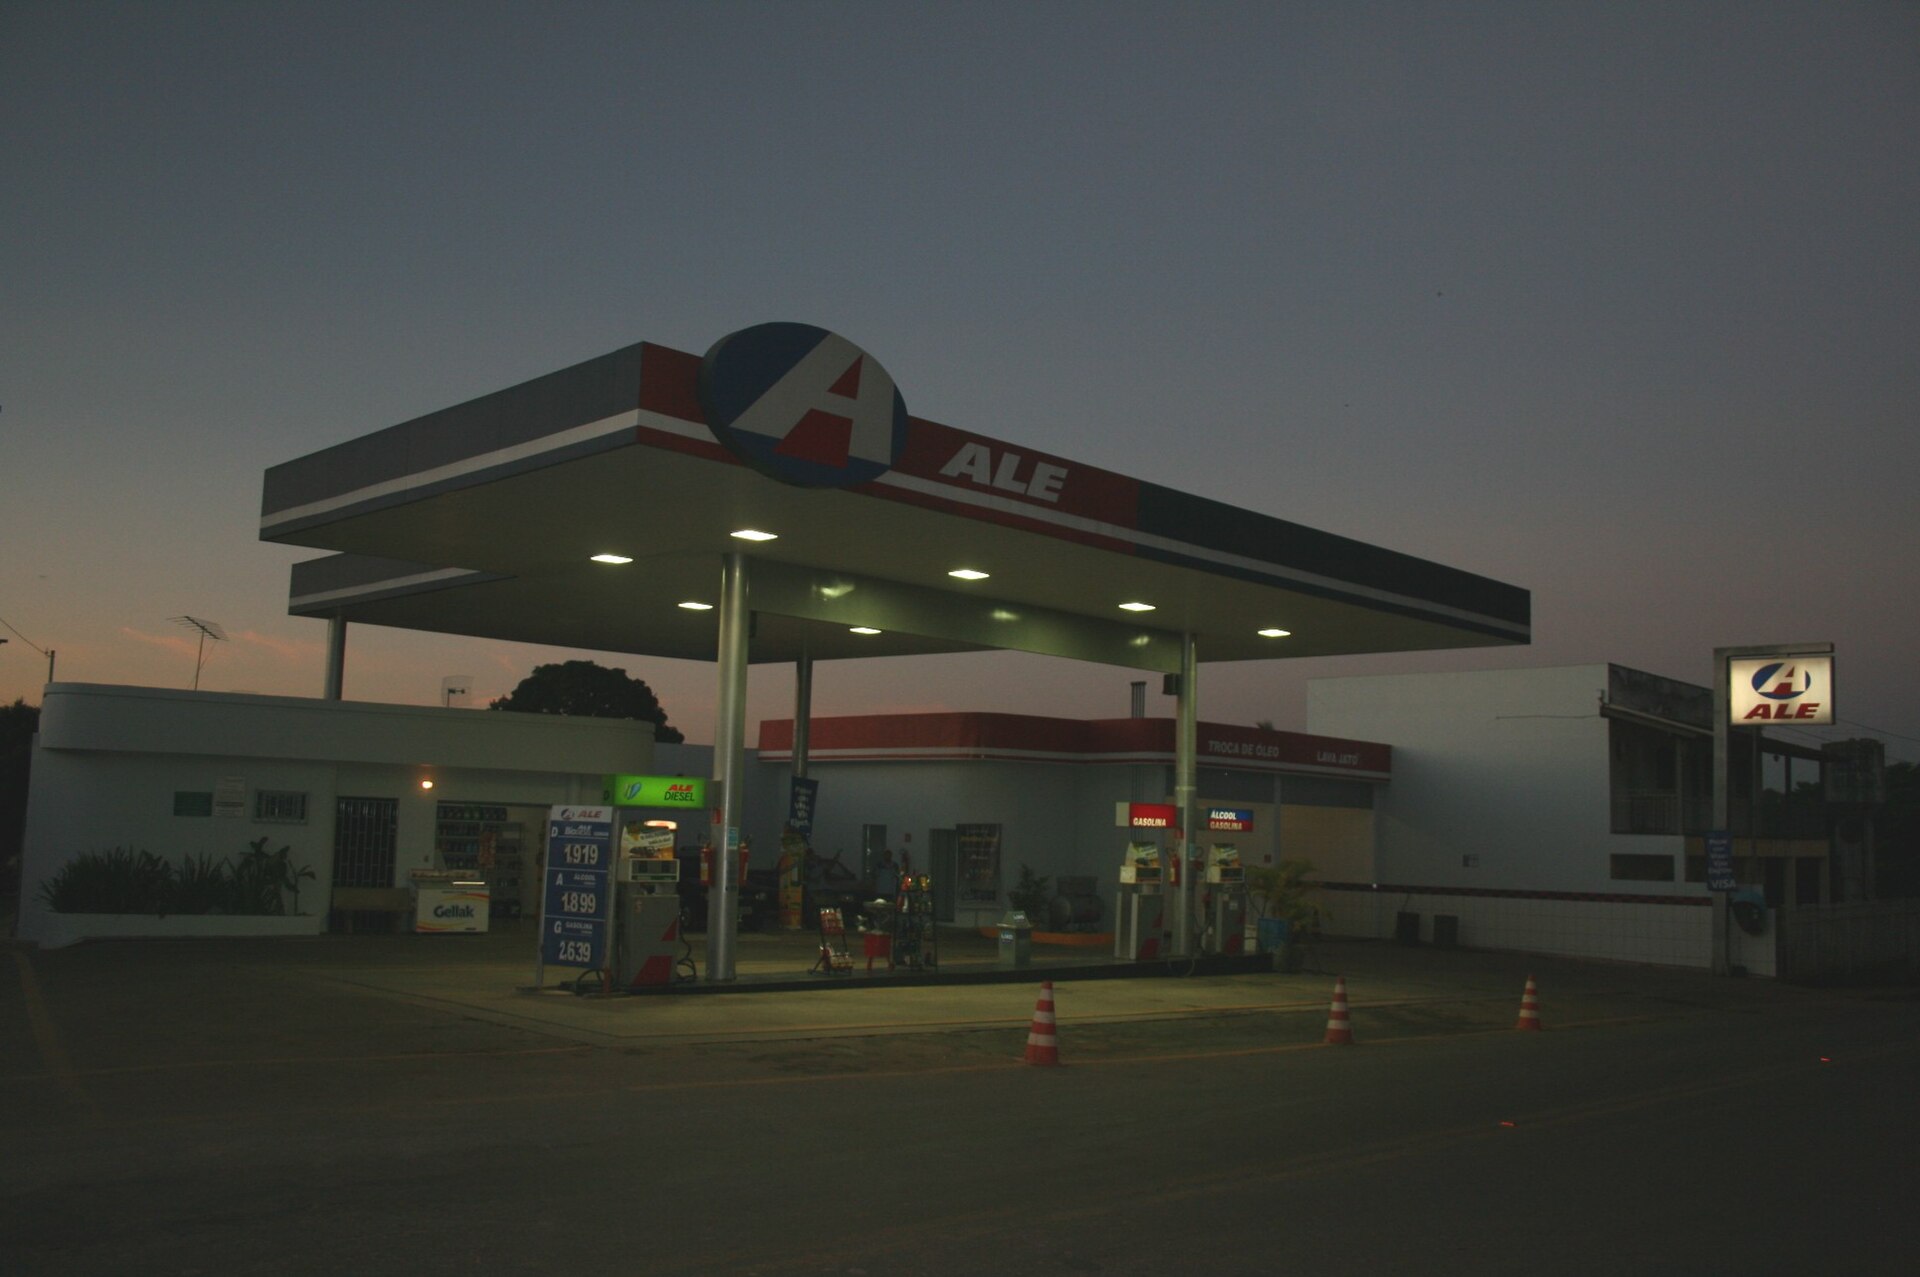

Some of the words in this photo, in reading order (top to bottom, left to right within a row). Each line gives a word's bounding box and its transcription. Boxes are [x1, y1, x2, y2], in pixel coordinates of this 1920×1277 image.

[938, 441, 1069, 504] ALE
[1743, 703, 1820, 719] ALE
[1208, 740, 1239, 754] TROCA
[1241, 743, 1253, 755] DE
[1255, 743, 1280, 757] ÓLEO
[1316, 751, 1336, 763] LAVA
[1338, 754, 1359, 765] JATO
[668, 784, 695, 792] ALE
[664, 791, 695, 801] DIESEL
[577, 810, 603, 818] ALE
[1133, 817, 1166, 827] GASOLINA
[1210, 821, 1243, 830] GASOLINA
[551, 826, 559, 838] D
[555, 872, 564, 886] A
[1711, 879, 1737, 889] VISA
[433, 905, 475, 918] Gellak
[553, 920, 562, 934] G
